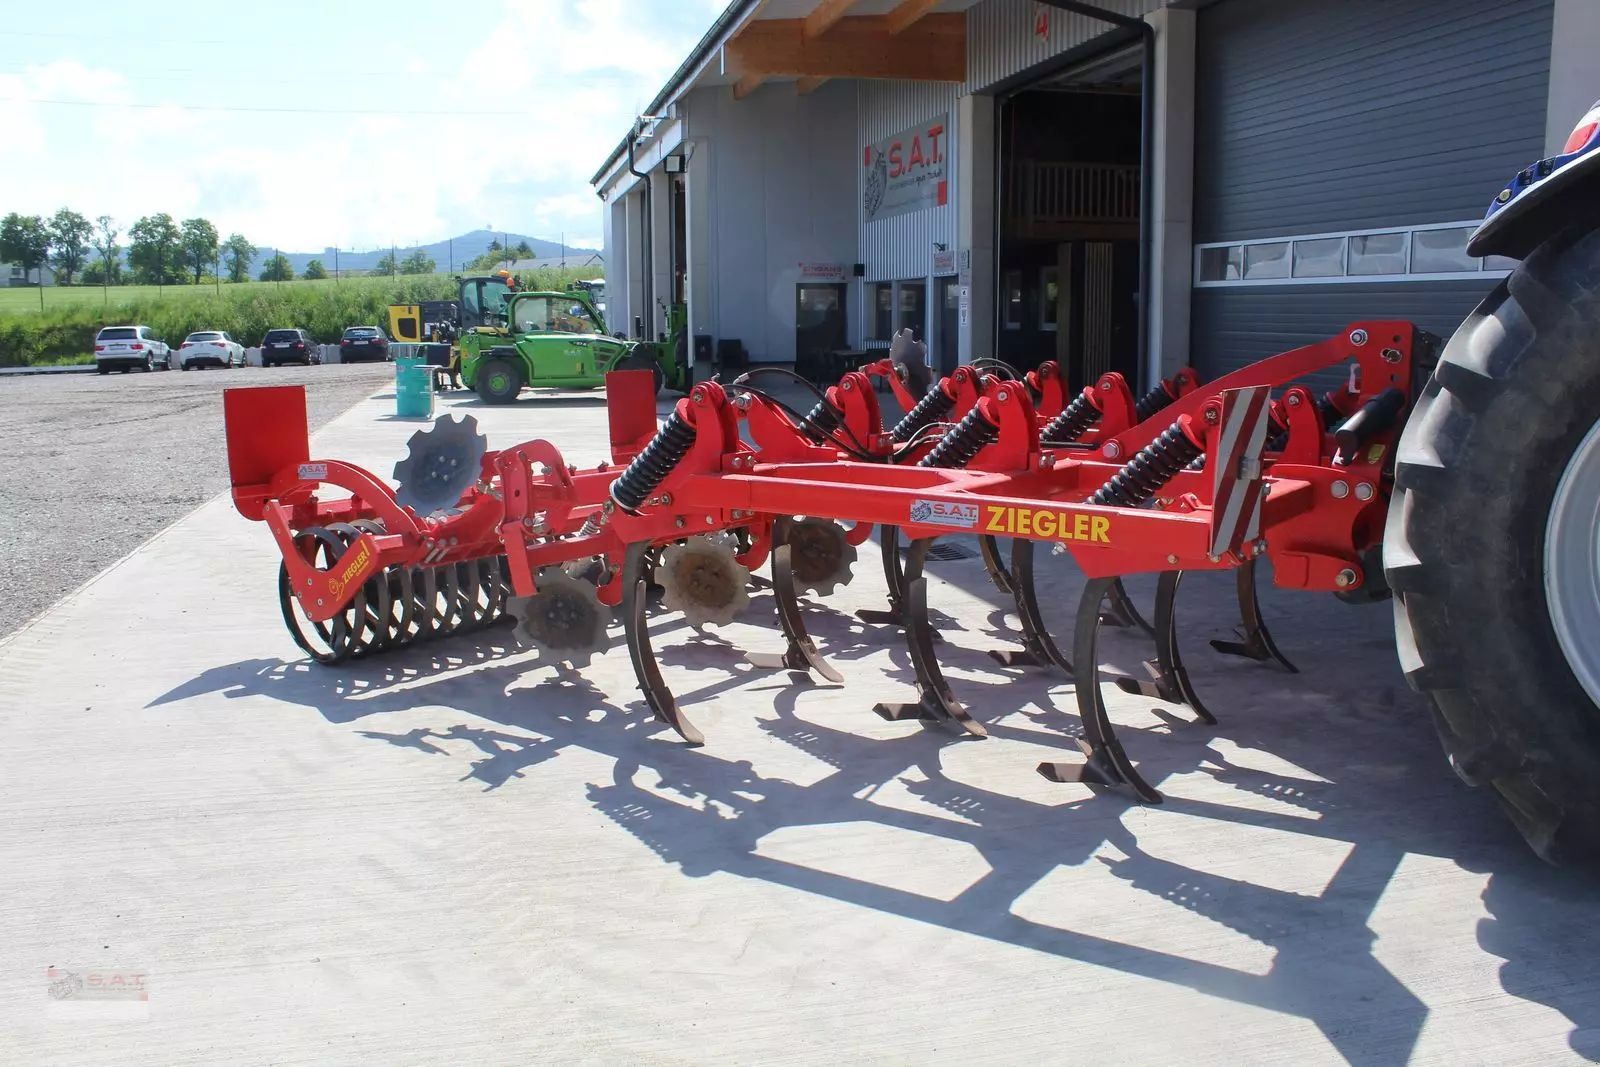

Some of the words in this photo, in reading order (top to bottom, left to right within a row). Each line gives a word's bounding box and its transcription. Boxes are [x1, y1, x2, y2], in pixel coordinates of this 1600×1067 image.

[1035, 12, 1049, 42] 4
[888, 124, 944, 178] S.A.T.
[933, 503, 978, 518] S.A.T.
[985, 505, 1111, 543] ZIEGLER
[341, 550, 368, 585] ZIEGLER
